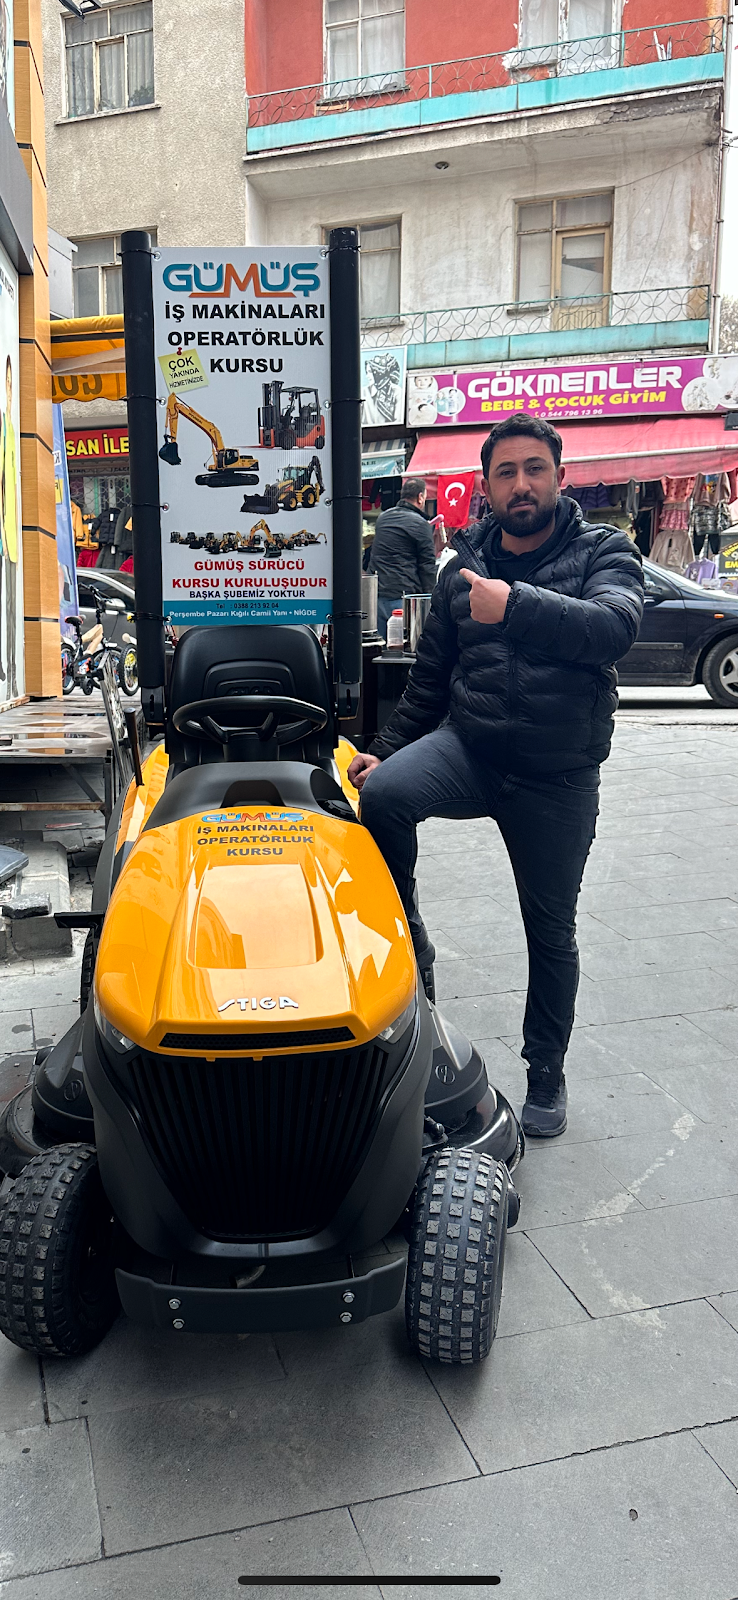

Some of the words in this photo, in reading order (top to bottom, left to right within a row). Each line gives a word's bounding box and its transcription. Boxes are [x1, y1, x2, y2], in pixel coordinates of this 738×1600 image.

[162, 261, 320, 298] GÜMÜŞ
[165, 300, 185, 323] İŞ
[192, 300, 325, 319] MAKİNALARI
[167, 327, 324, 346] OPERATÖRLÜK
[168, 356, 195, 372] ÇOK
[210, 358, 283, 373] KURSU
[169, 367, 200, 379] YAKINDA
[467, 365, 683, 400] GÖKMENLER
[481, 399, 525, 413] BEBE
[528, 399, 541, 409] &
[544, 394, 605, 411] ÇOCUK
[609, 389, 667, 405] GİYİM
[194, 559, 244, 573] GÜMÜŞ
[248, 558, 305, 571] SÜRÜCÜ
[172, 578, 220, 588] KURSU
[224, 577, 327, 590] KURULUŞUDUR
[189, 590, 221, 600] BAŞKA
[223, 589, 265, 600] ŞUBEMİZ
[268, 590, 306, 598] YOKTUR
[230, 610, 249, 618] Kığılı
[250, 609, 271, 617] Camii
[201, 812, 304, 824] GÜMÜŞ
[227, 847, 283, 856] KURSU
[217, 996, 299, 1012] STIGA
